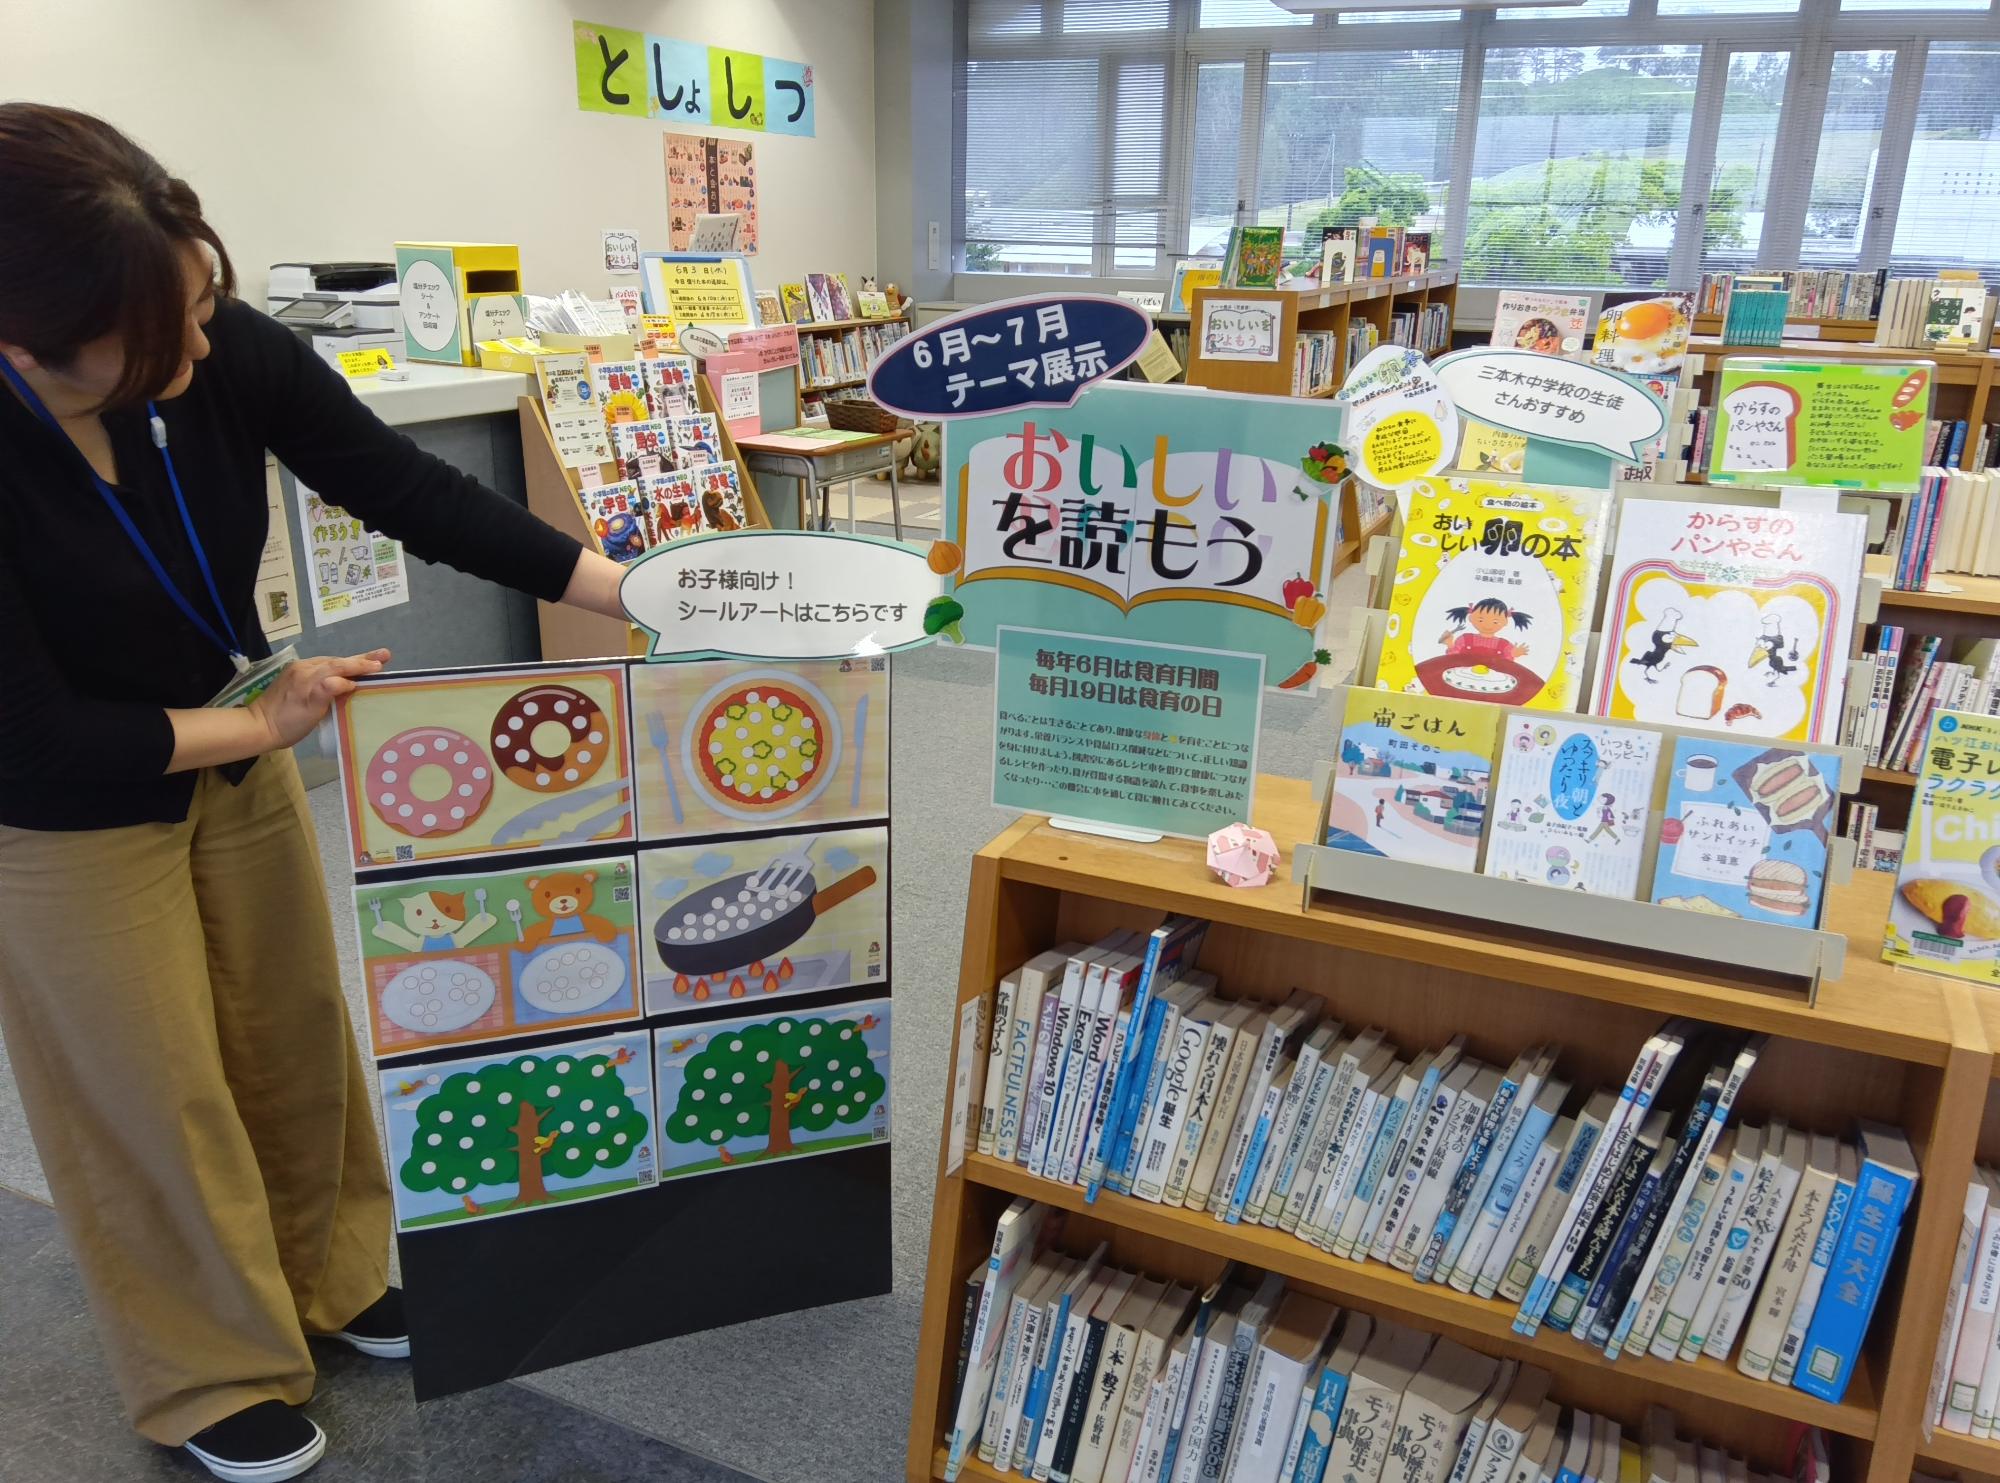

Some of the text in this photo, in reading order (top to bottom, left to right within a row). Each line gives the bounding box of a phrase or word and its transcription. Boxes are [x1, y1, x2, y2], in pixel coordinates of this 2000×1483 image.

[598, 34, 806, 122] としょしつ
[1210, 318, 1271, 331] おいしいを
[1596, 309, 1623, 363] 卵料理
[945, 341, 1109, 408] テーマ展示
[1477, 365, 1625, 411] 三本木中学校の生徒
[1493, 391, 1587, 424] さんおすすめ
[1730, 420, 1785, 433] パンやさん
[1732, 401, 1782, 415] からすの
[1003, 421, 1278, 510] おいしい
[603, 495, 628, 514] 宇宙
[654, 481, 693, 500] 水の生物
[1485, 499, 1538, 509] 食べ物の絵本
[992, 491, 1264, 587] を読もう
[1687, 511, 1795, 535] からすの
[1670, 536, 1803, 562] パンやさん
[677, 568, 794, 591] お子様向け！
[677, 600, 908, 623] シールアートはこちらです
[1036, 649, 1220, 691] 毎年6月は食育月間
[1028, 673, 1223, 718] 毎月19日は食育の日
[1372, 707, 1467, 737] 宙ごはん
[1388, 738, 1442, 754] 町田そのこ
[1600, 738, 1633, 750] いつも
[1688, 829, 1761, 847] サンドイッチ
[1696, 816, 1756, 831] ふれあい
[1043, 1006, 1071, 1097] Windows 10
[1071, 1009, 1093, 1056] Excel
[1088, 1017, 1111, 1064] Word
[998, 1018, 1030, 1139] FACTFULNESS
[1164, 1027, 1202, 1102] Google
[1189, 1033, 1229, 1122] 壊れる日本人
[1409, 1115, 1440, 1169] 中年の本棚
[1451, 1102, 1481, 1154] 加藤哲夫の
[1172, 1157, 1189, 1191] 柳田邦
[1741, 1166, 1774, 1228] 絵本の森へ
[1782, 1189, 1821, 1273] 本をつんだ小舟
[1165, 1363, 1182, 1397] 本の本
[1323, 1380, 1339, 1411] 日本
[1186, 1400, 1209, 1462] 日本の国力
[1337, 1407, 1361, 1445] 事典
[1350, 1395, 1384, 1473] モノの歴史
[1369, 1401, 1394, 1477] 年表で見る
[1389, 1425, 1413, 1462] 事典
